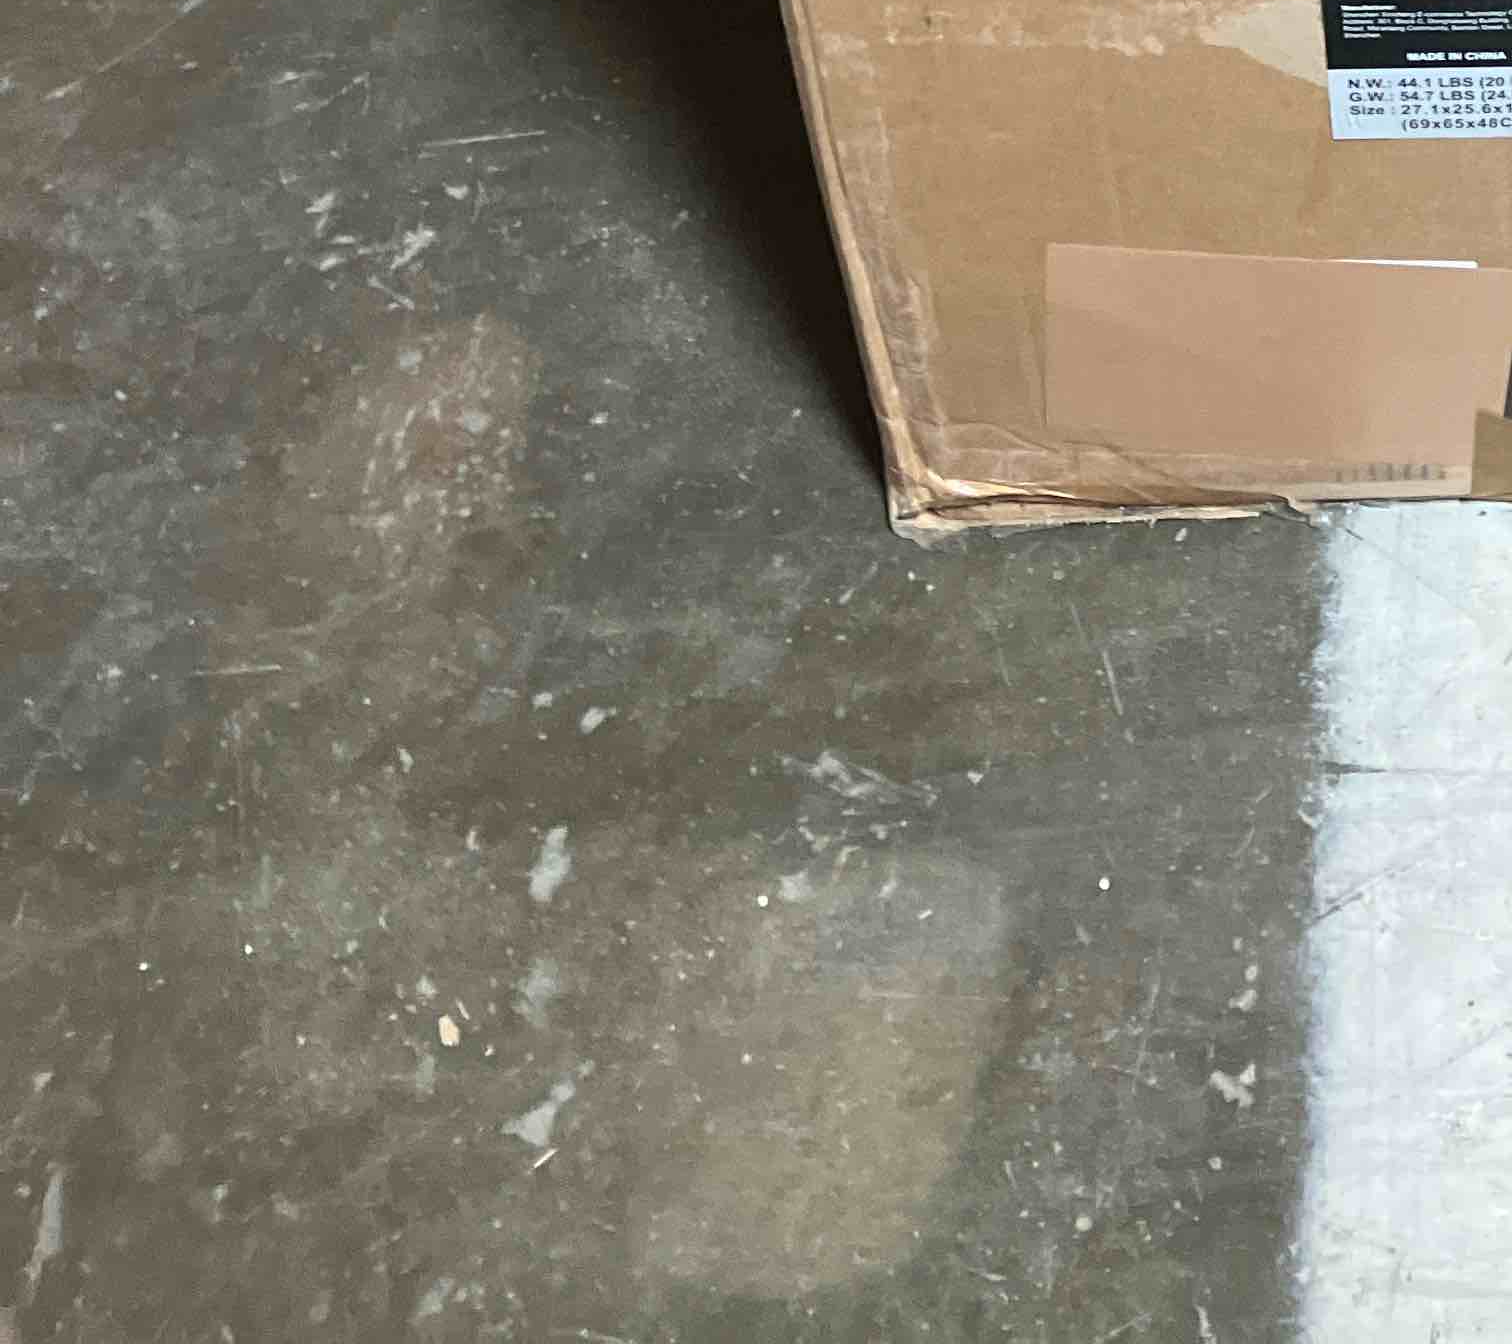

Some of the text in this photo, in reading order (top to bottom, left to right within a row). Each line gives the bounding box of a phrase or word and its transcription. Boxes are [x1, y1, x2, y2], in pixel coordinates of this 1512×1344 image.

[1406, 51, 1507, 61] MADE IN CHINA
[1397, 77, 1432, 88] 44.1
[1438, 77, 1474, 88] LBS
[1479, 76, 1505, 89] (20
[1400, 91, 1434, 102] 54.7
[1440, 91, 1475, 102] LBS
